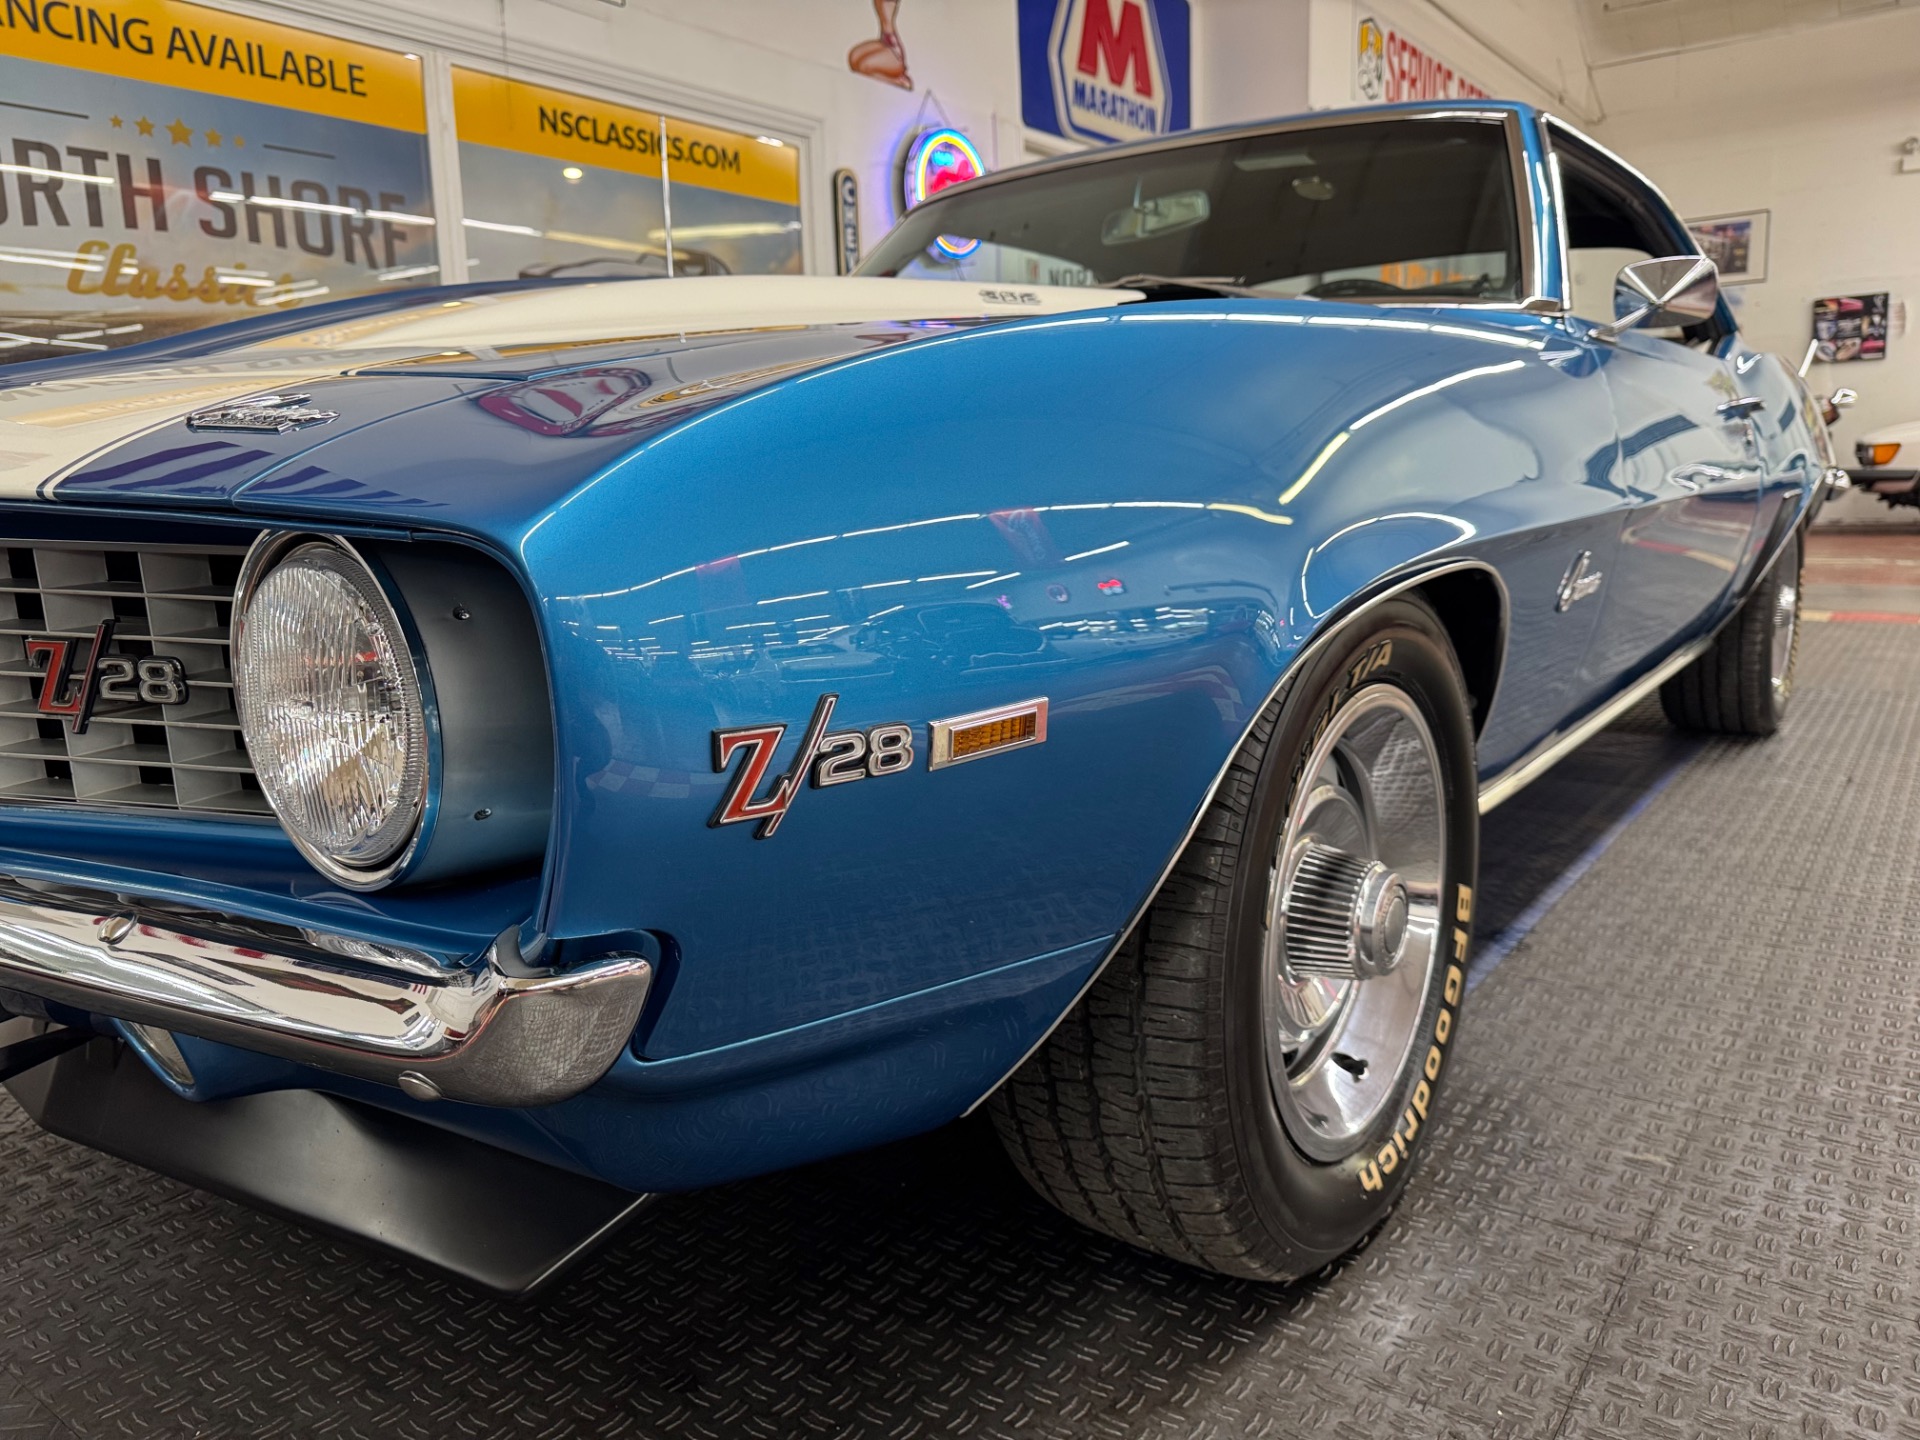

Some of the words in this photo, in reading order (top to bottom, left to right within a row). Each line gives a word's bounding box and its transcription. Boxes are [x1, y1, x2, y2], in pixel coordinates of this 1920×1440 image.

[0, 0, 154, 55] NCING
[166, 26, 367, 98] AVAILABLE
[1077, 0, 1153, 99] M
[539, 106, 741, 174] NSCLASSICS.COM
[1072, 79, 1157, 135] MARATHON
[0, 138, 169, 232] RTH
[25, 619, 188, 734] Z/28
[1348, 640, 1393, 689] T/A
[707, 692, 914, 840] Z/28
